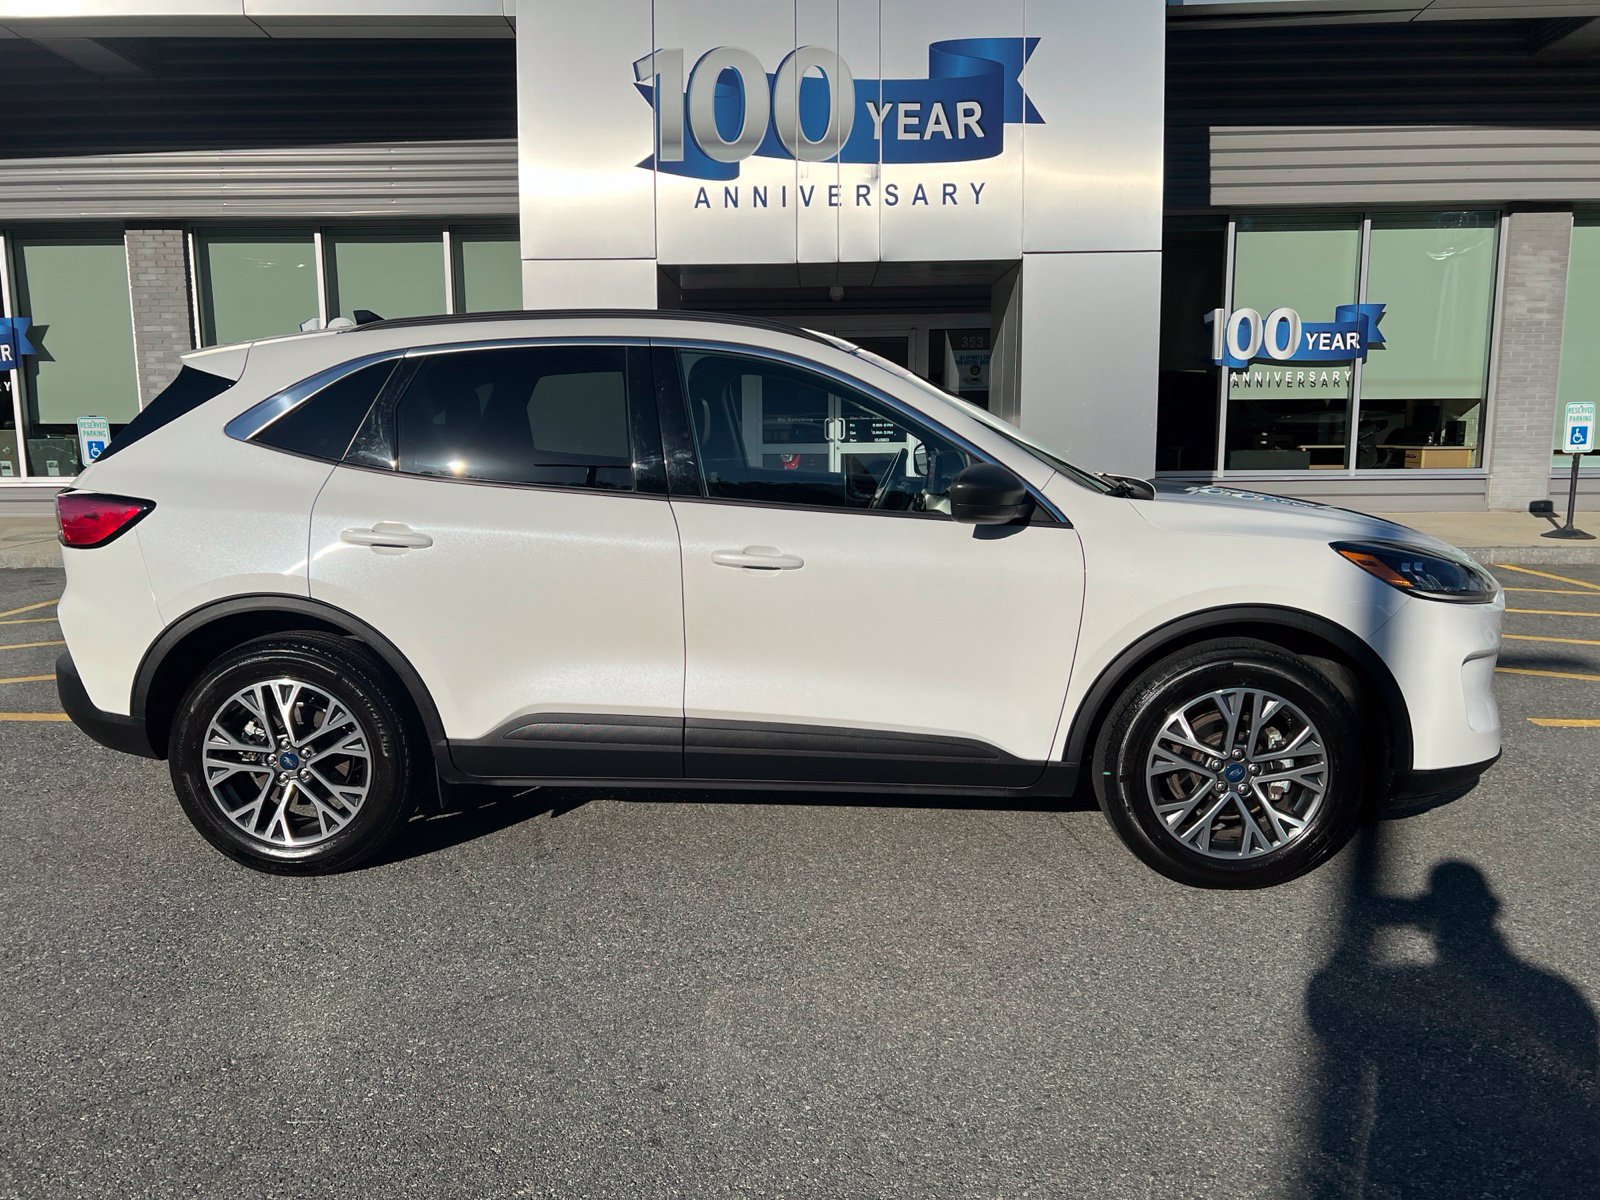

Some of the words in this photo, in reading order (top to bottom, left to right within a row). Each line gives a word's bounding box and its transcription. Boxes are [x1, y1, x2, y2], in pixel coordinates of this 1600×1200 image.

[632, 45, 856, 163] 100
[865, 101, 986, 141] YEAR
[694, 182, 986, 209] ANNIVERSARY
[1203, 307, 1302, 360] 100
[1306, 332, 1361, 351] YEAR
[961, 336, 984, 348] 353
[0, 344, 13, 362] R
[1230, 371, 1352, 382] ANNIVERSARY
[1569, 415, 1592, 423] PARKING
[83, 430, 107, 438] PARKING
